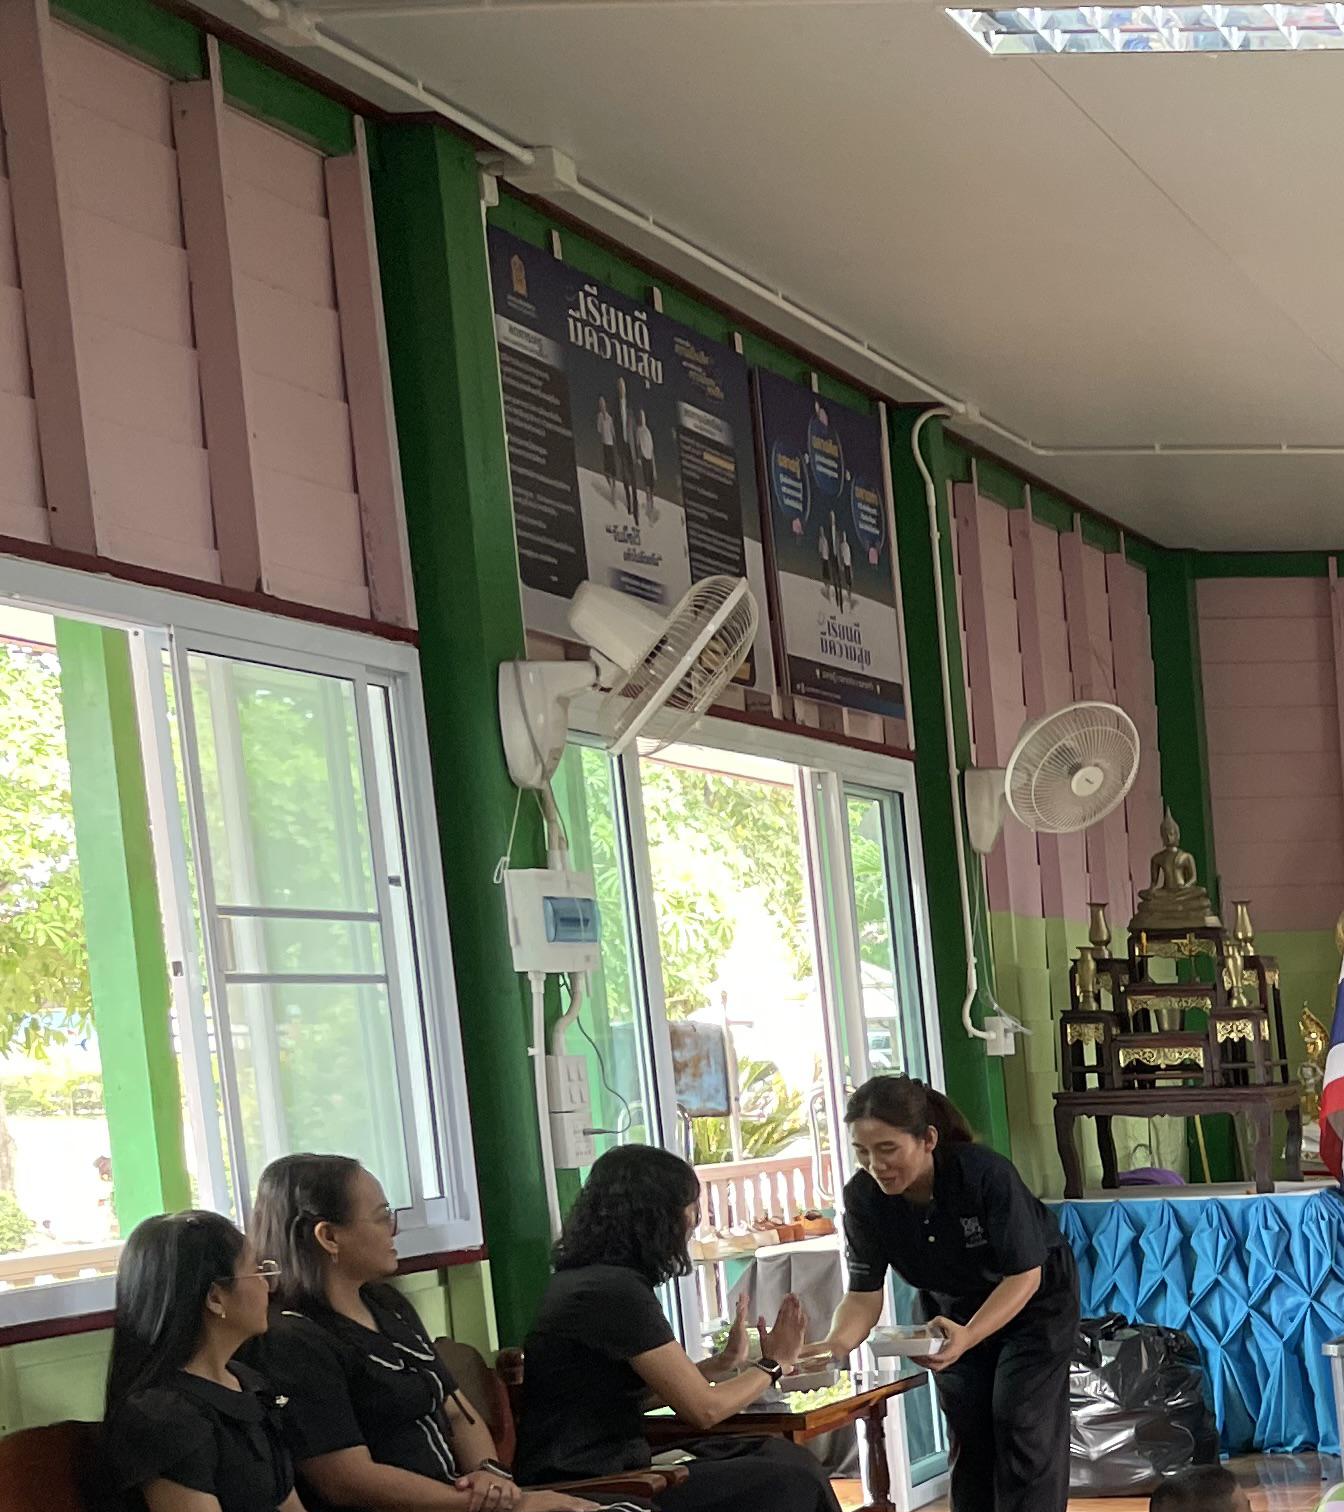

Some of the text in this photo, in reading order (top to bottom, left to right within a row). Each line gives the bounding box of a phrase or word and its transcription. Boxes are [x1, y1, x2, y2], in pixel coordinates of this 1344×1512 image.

[568, 308, 664, 389] มีความสุข
[578, 284, 650, 351] เรียนดี
